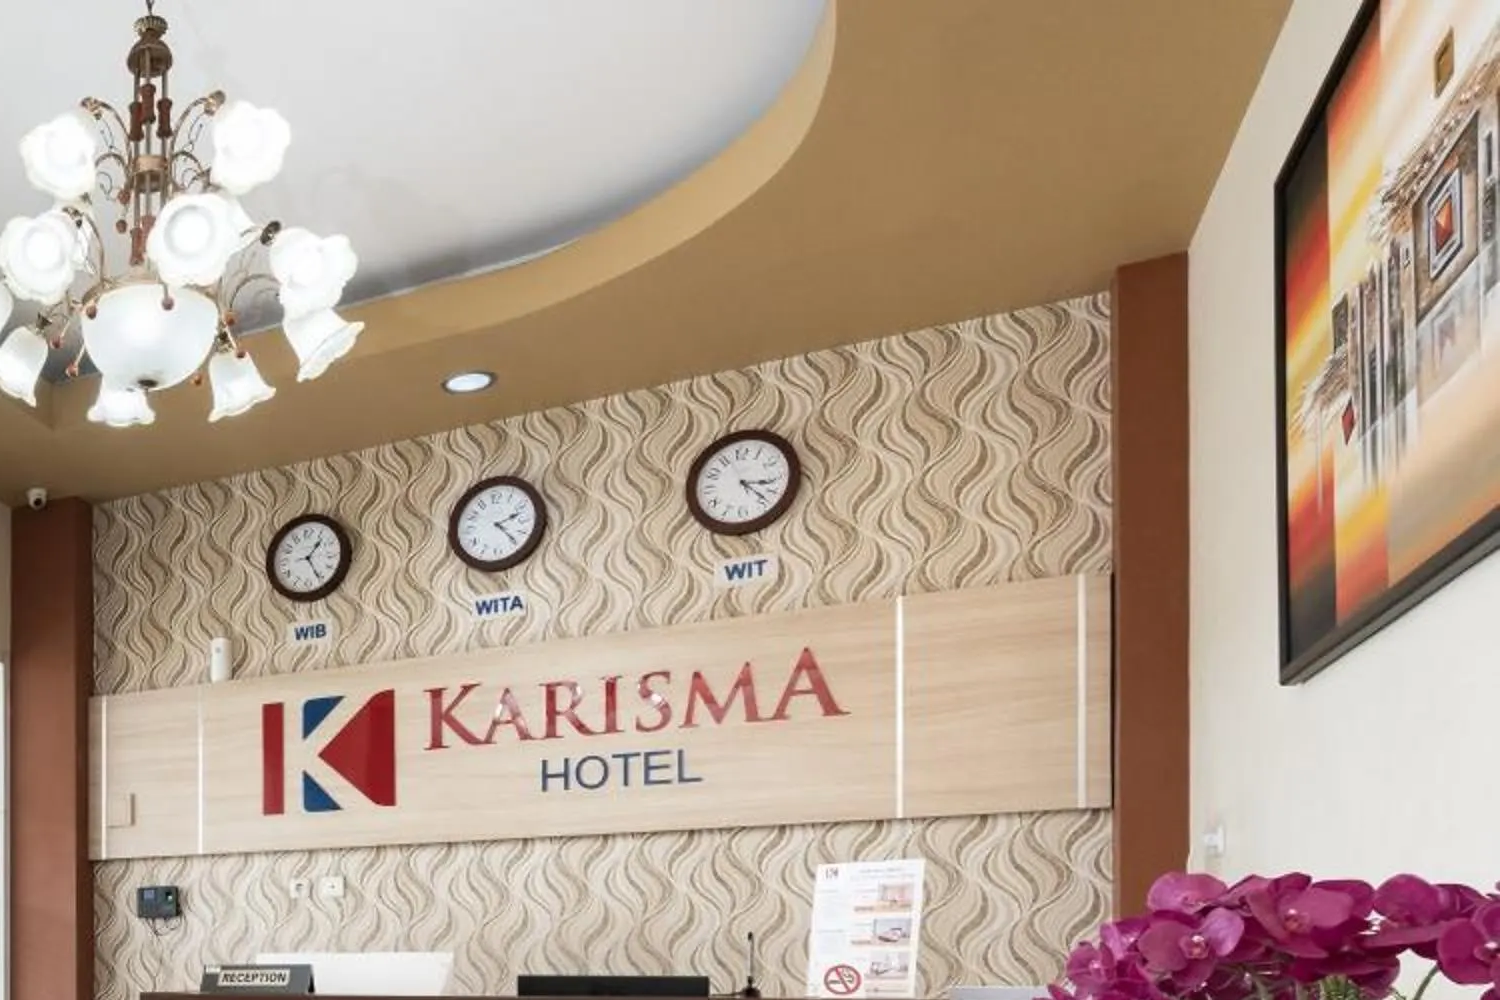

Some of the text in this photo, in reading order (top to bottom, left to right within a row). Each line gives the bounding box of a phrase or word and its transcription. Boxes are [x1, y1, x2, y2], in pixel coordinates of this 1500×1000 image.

[724, 559, 769, 581] WIT
[475, 595, 524, 616] WITA
[293, 623, 327, 641] WIB
[422, 646, 852, 751] KARISMA
[540, 748, 703, 793] HOTEL
[221, 972, 288, 984] RECEPTION
